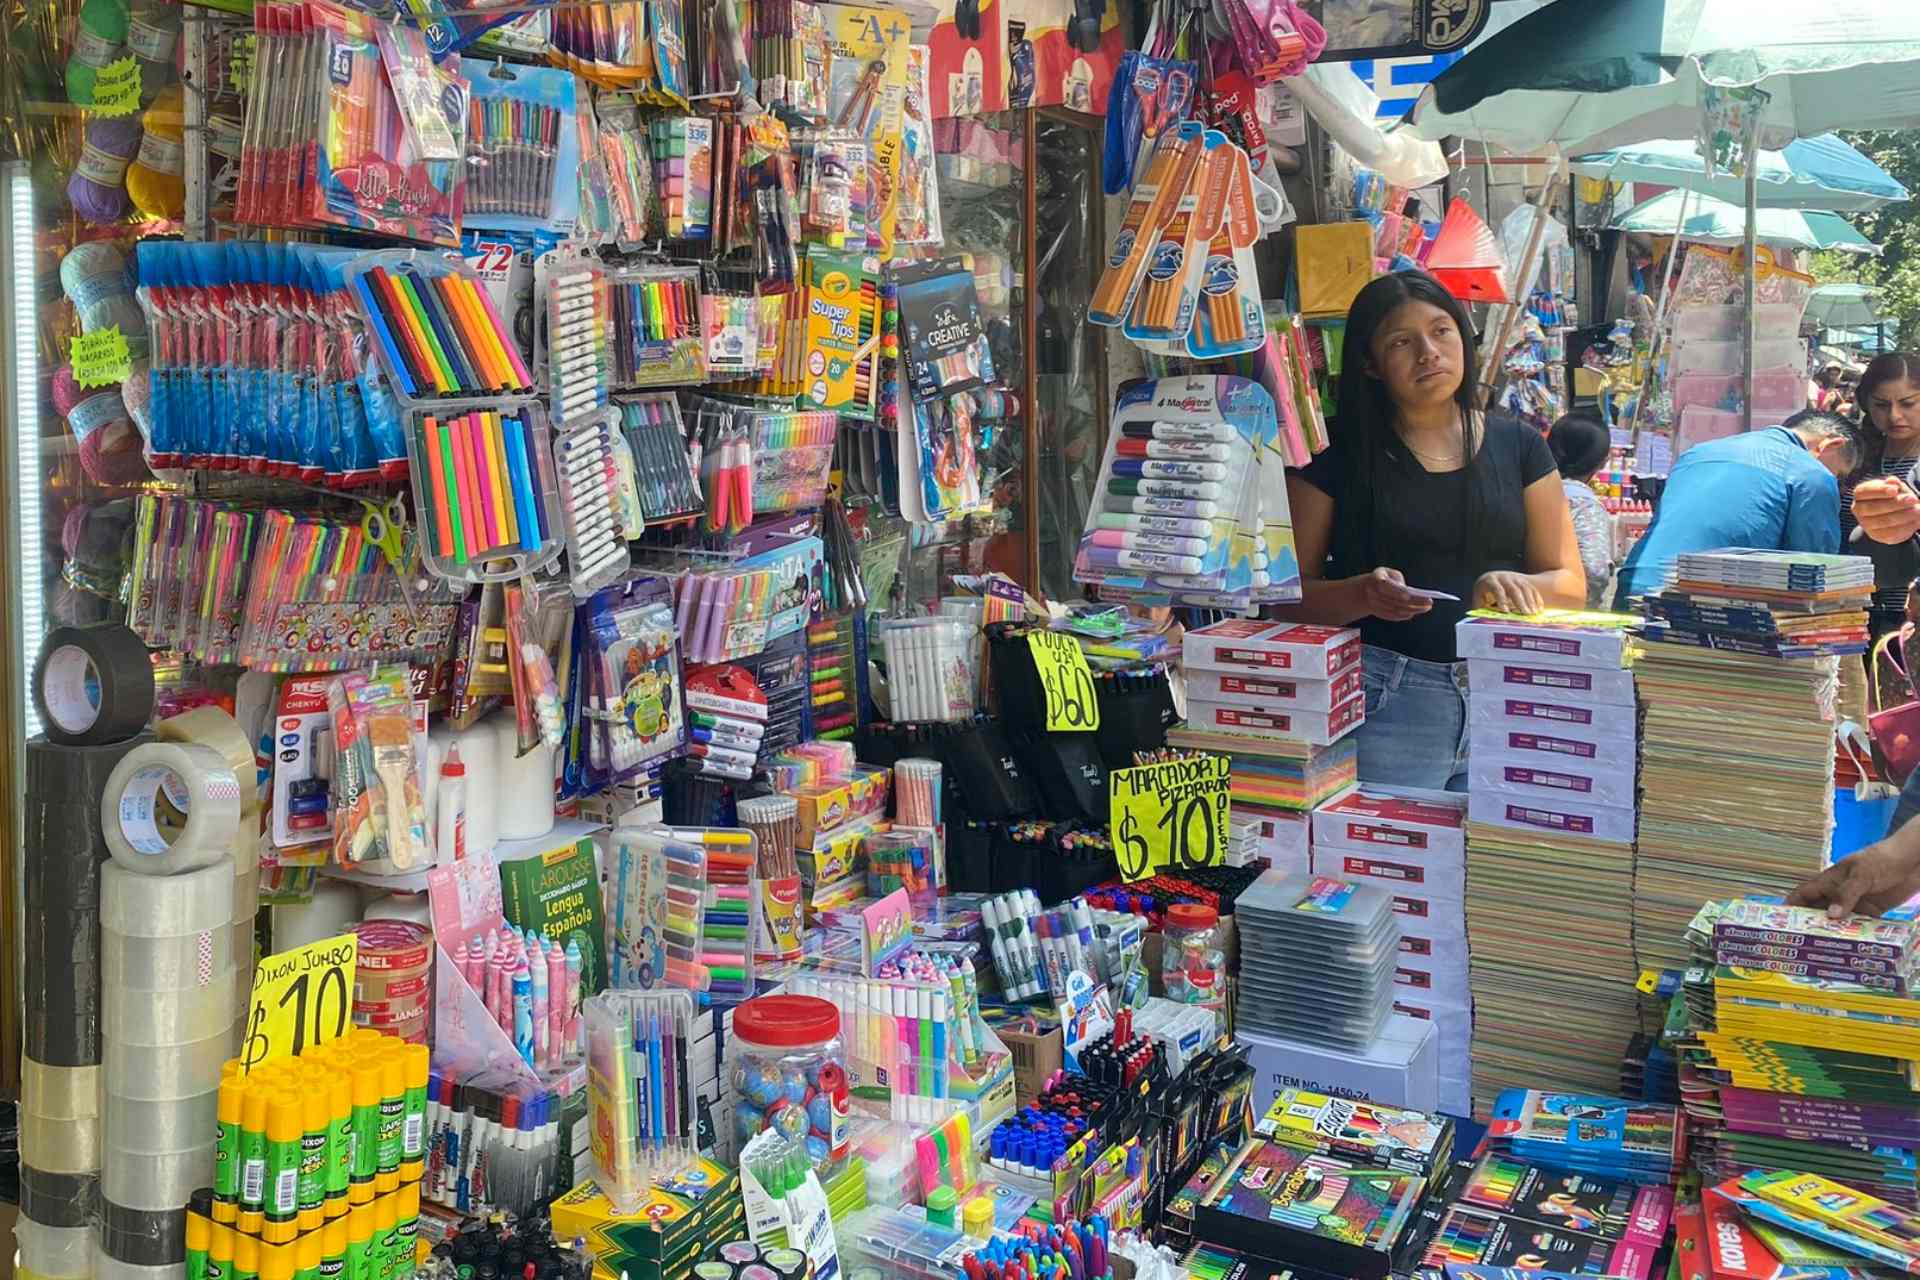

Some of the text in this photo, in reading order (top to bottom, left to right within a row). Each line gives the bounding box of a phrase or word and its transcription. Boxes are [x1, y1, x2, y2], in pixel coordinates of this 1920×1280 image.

[476, 241, 513, 272] 72
[811, 299, 851, 321] Super
[830, 319, 855, 339] Tips
[927, 323, 971, 347] CREATIVE
[1045, 664, 1096, 726] $60
[1113, 758, 1213, 796] MARCADOR
[530, 853, 593, 895] LAROUSSE
[545, 892, 585, 917] Lengua
[543, 907, 593, 938] Española
[254, 944, 353, 991] DIXON JUMBO
[1272, 1073, 1300, 1090] ITEM
